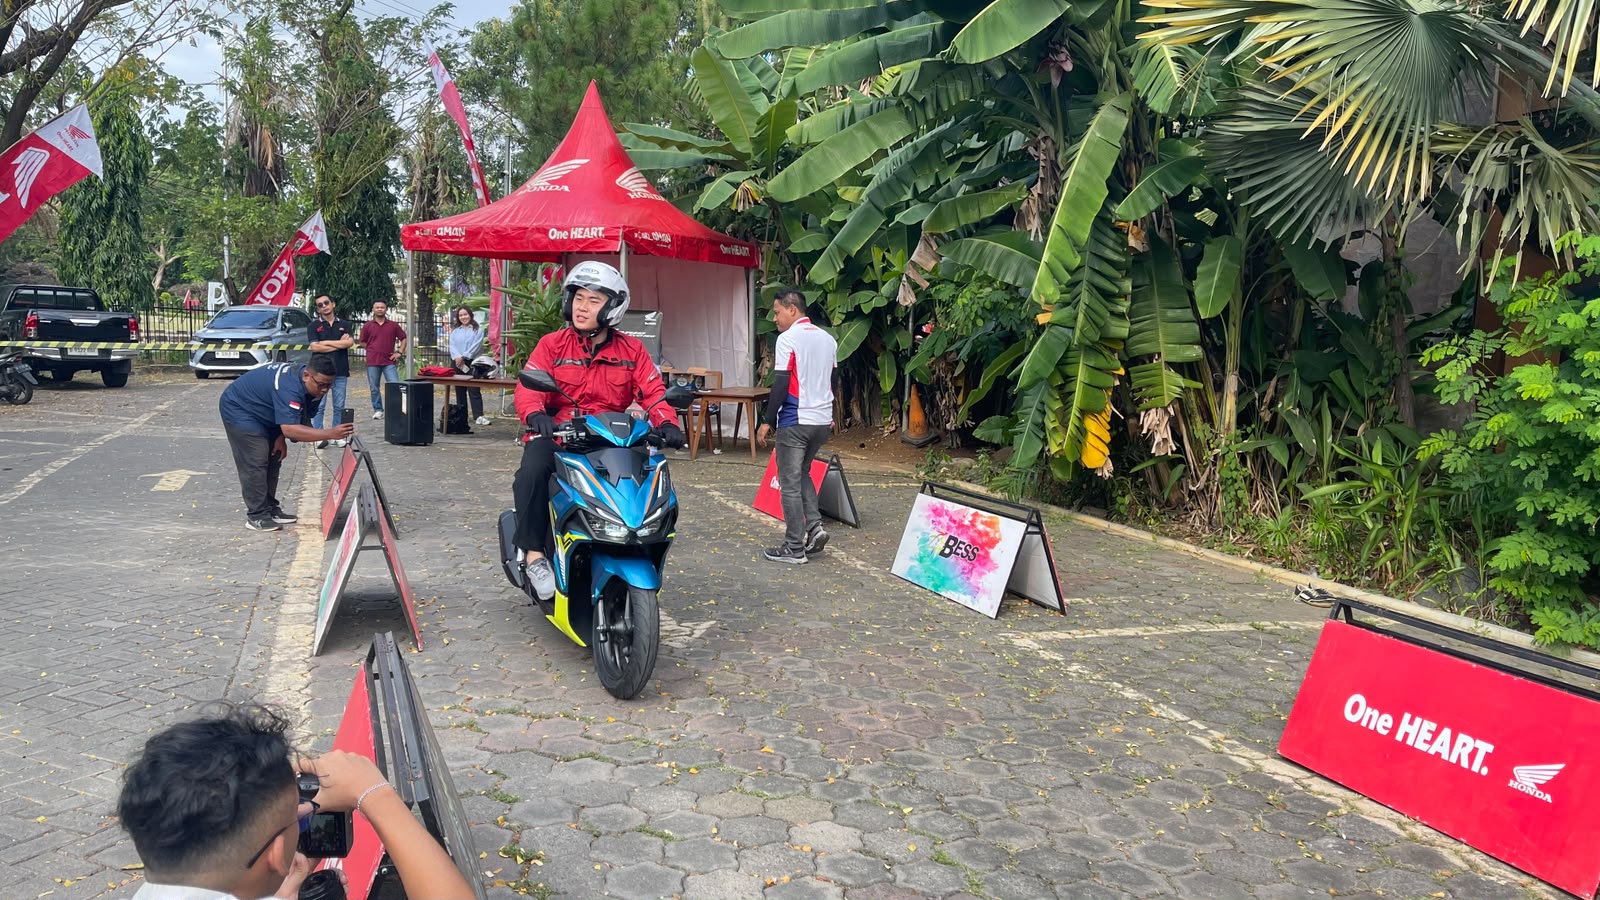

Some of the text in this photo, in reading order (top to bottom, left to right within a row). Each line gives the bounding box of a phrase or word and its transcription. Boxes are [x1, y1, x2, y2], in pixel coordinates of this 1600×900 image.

[548, 226, 605, 240] One HEART.
[938, 534, 980, 562] BESS
[1343, 693, 1495, 776] One HEART.
[1507, 779, 1553, 803] HONDA
